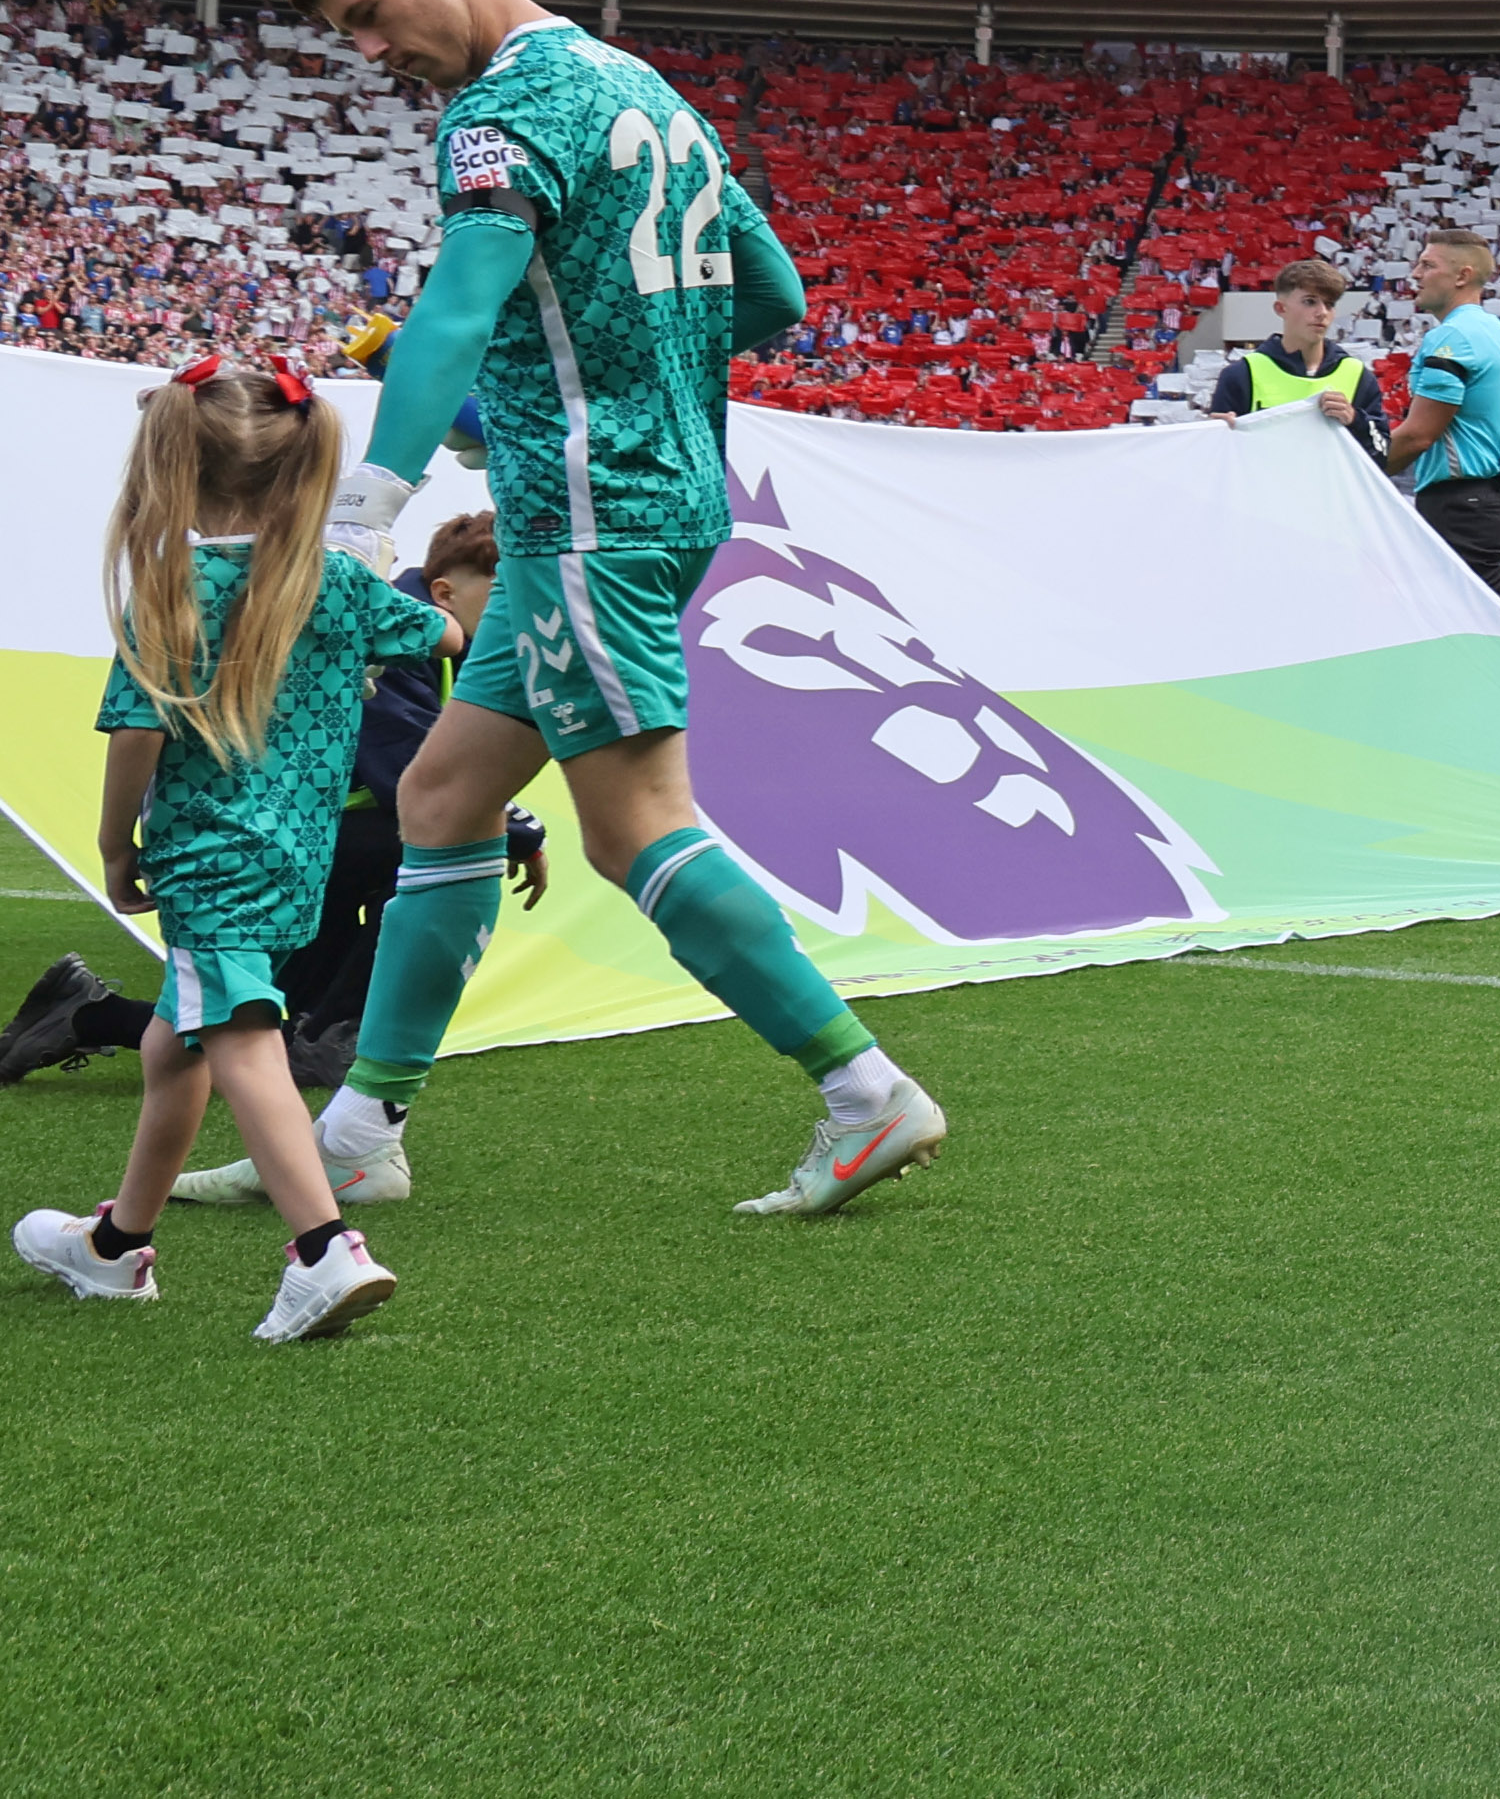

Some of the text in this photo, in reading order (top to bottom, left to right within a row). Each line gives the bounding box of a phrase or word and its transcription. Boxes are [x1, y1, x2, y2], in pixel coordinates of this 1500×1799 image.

[451, 127, 502, 154] Live
[453, 144, 525, 175] Score
[458, 169, 506, 194] Bet
[609, 107, 734, 296] 22
